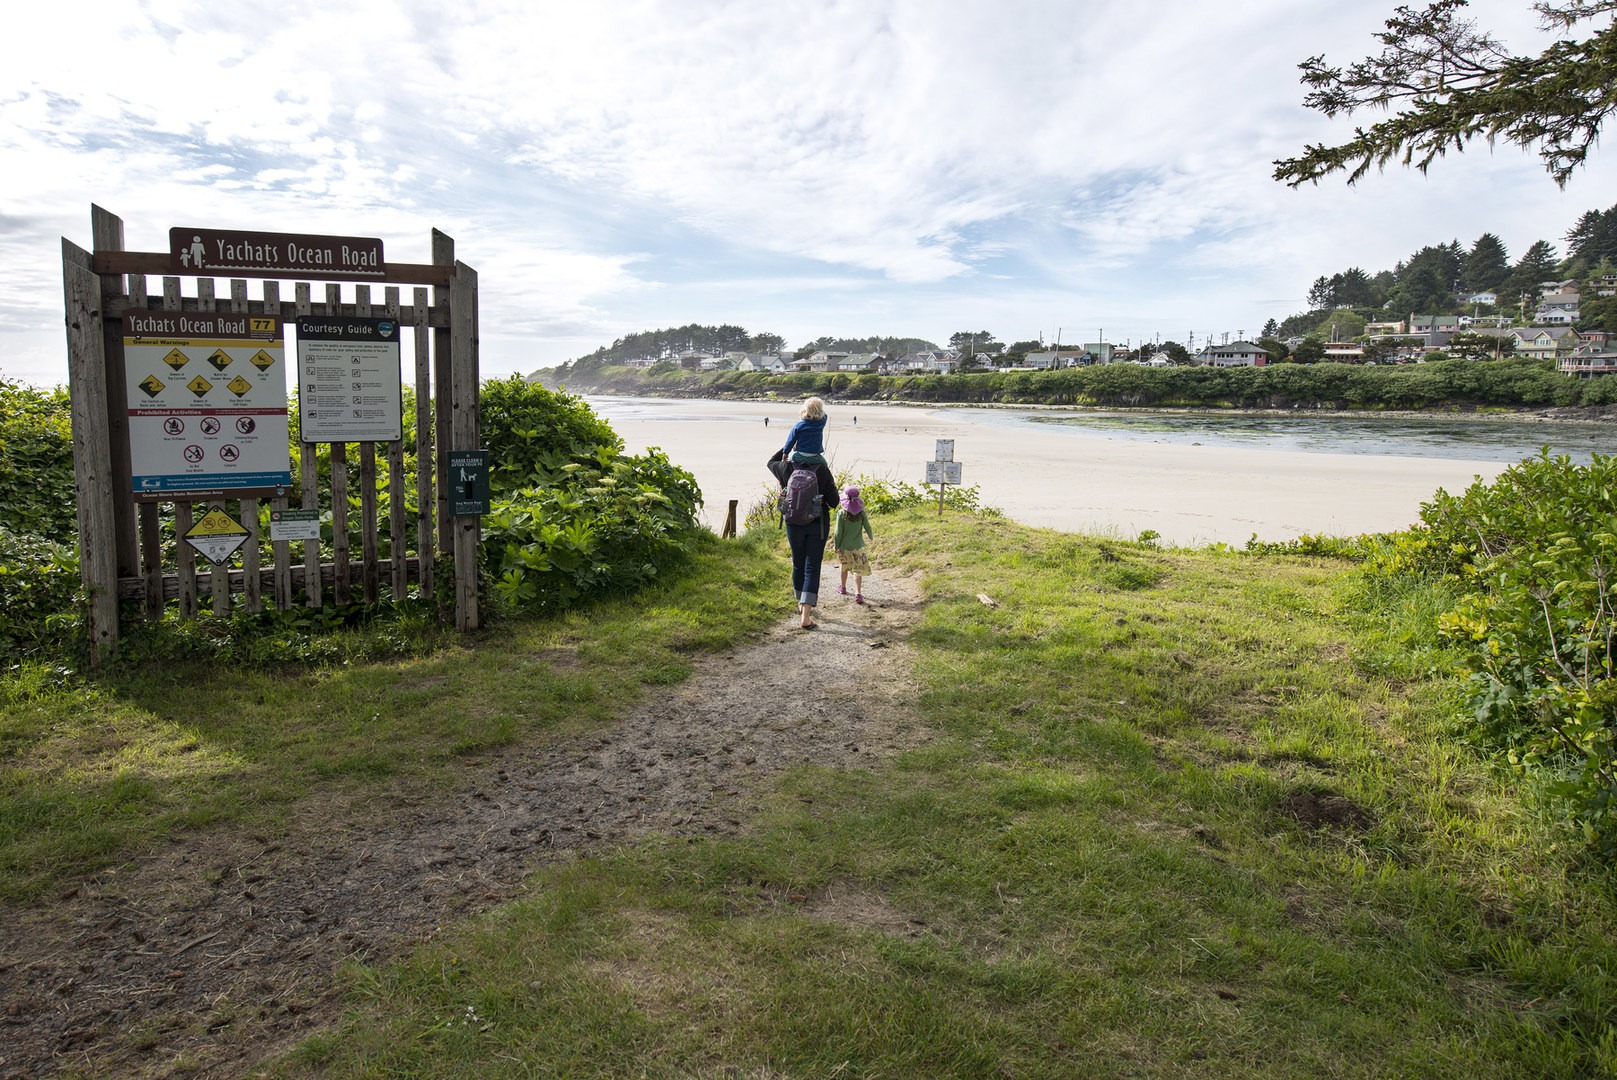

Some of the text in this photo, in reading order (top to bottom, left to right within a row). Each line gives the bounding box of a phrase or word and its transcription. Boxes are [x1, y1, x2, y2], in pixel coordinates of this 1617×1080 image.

[217, 240, 377, 266] Yachats Ocean Road
[129, 316, 270, 334] Yachats Ocean Road 77
[302, 323, 372, 335] Courtesy Guide
